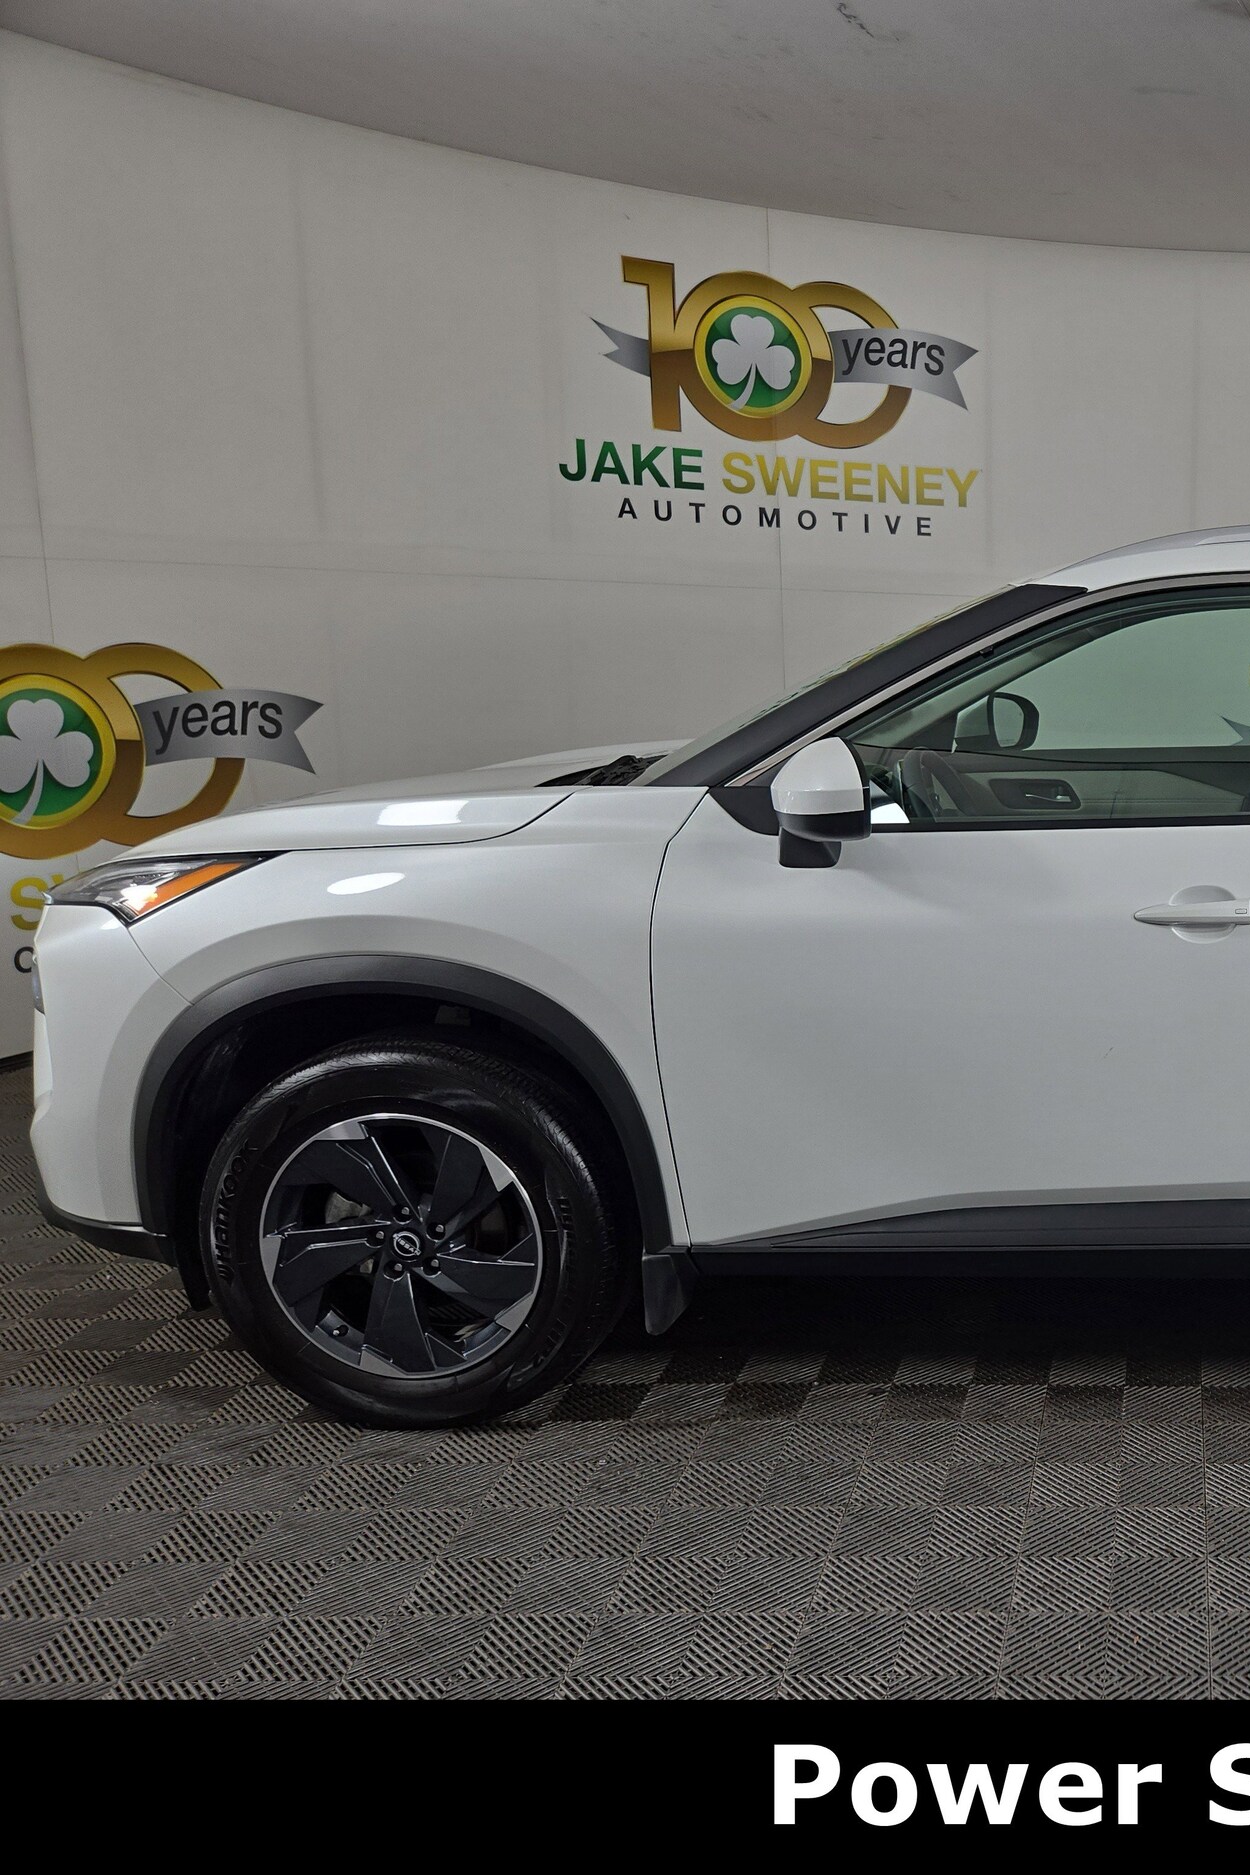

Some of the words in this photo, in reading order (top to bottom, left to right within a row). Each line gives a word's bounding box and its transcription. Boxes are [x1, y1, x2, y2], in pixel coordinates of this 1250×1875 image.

[841, 336, 945, 376] years
[558, 438, 705, 490] JAKE
[721, 452, 979, 507] SWEENEY
[617, 497, 932, 537] AUTOMOTIVE
[153, 700, 283, 756] years
